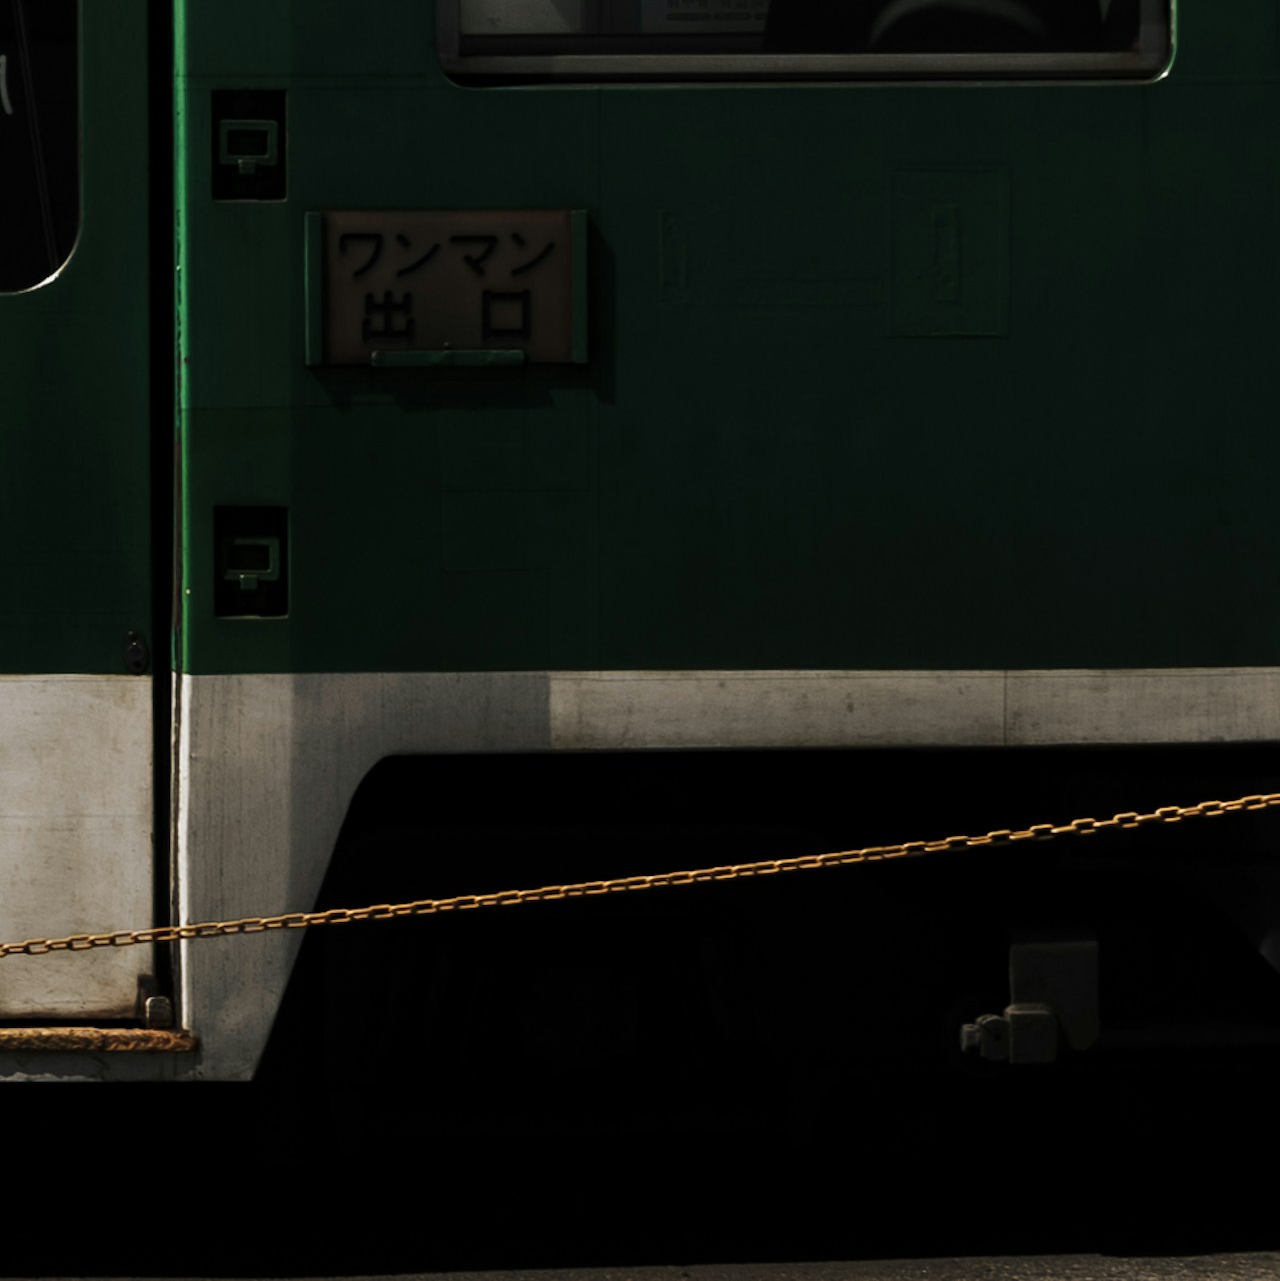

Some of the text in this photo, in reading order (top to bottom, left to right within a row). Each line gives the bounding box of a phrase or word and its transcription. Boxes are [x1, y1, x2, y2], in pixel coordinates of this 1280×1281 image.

[339, 232, 556, 278] ワンマン
[361, 289, 534, 344] 出口
